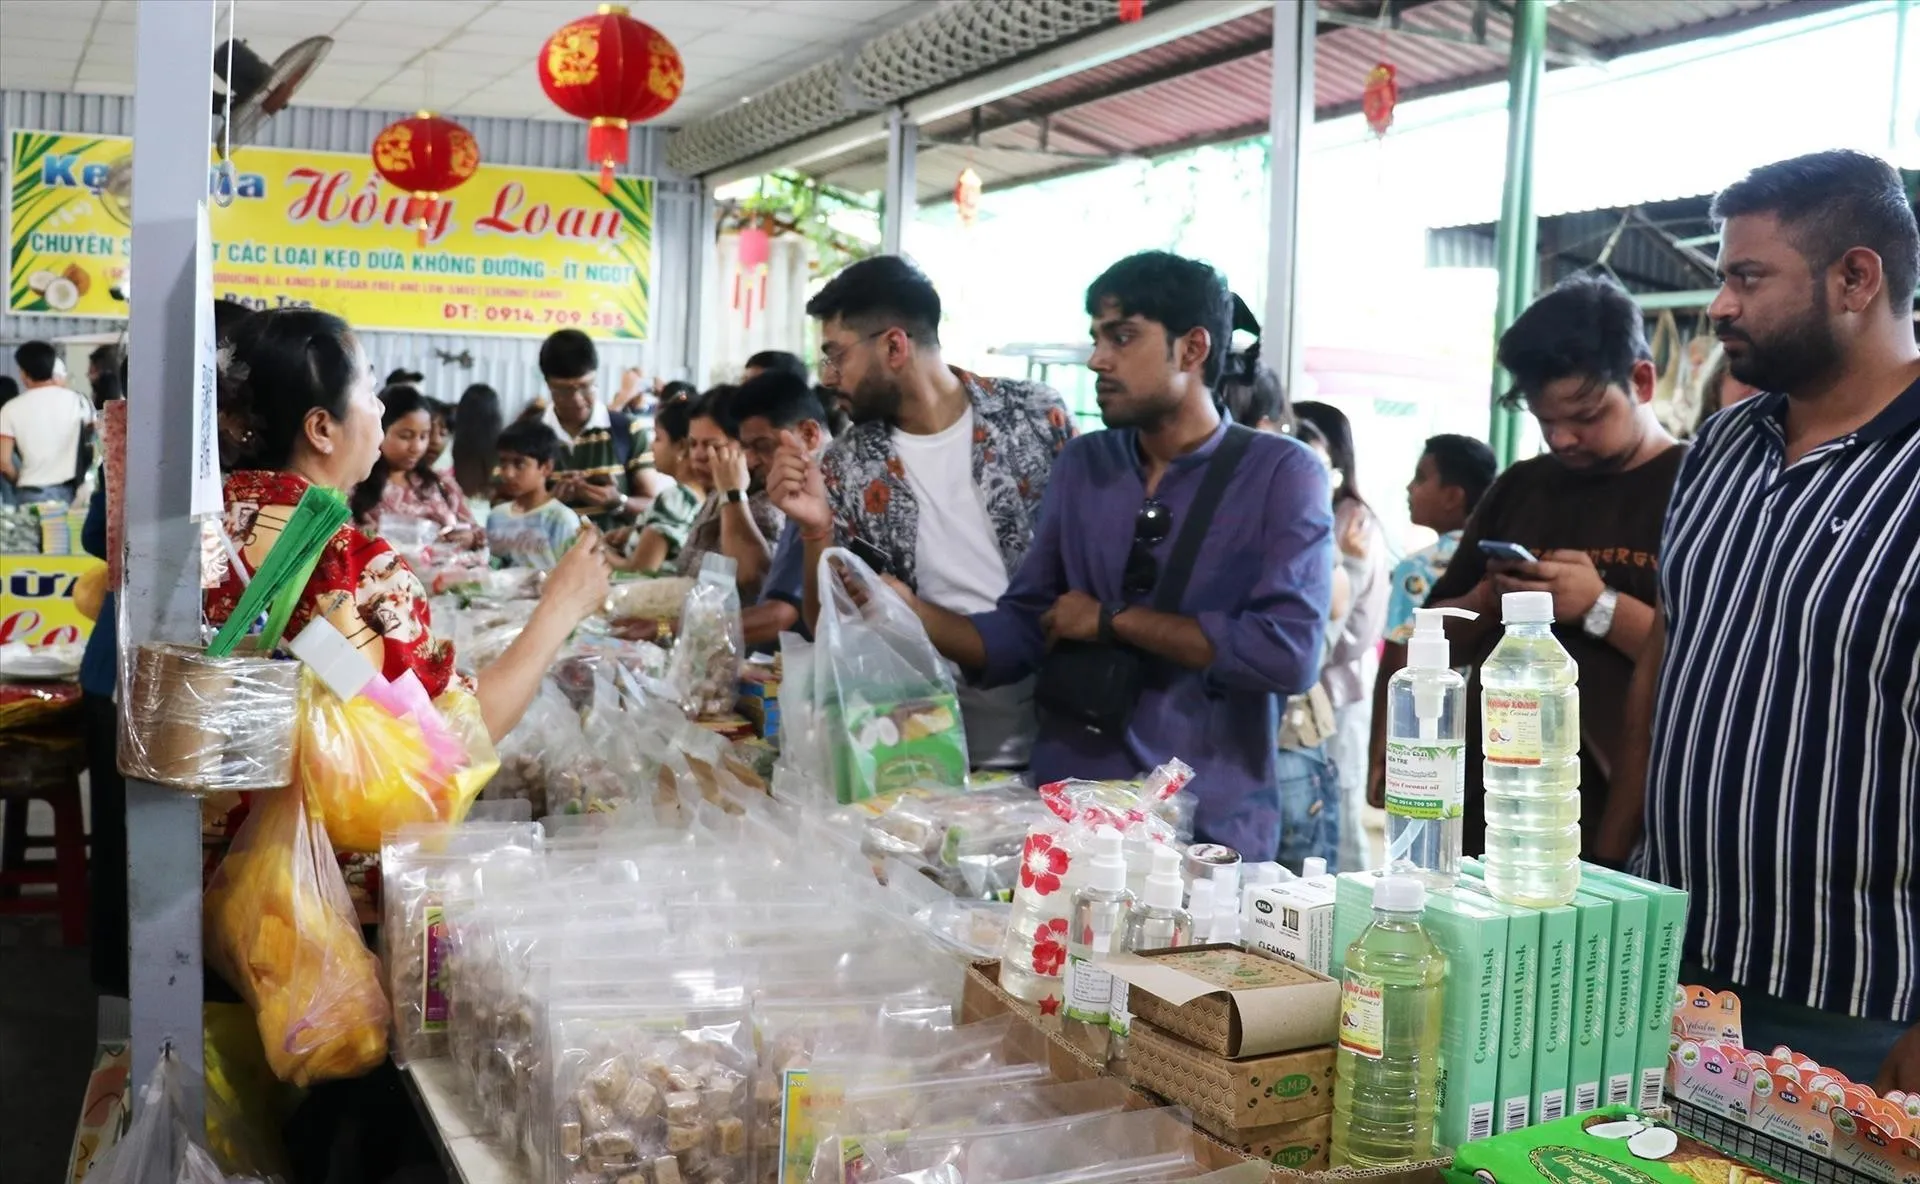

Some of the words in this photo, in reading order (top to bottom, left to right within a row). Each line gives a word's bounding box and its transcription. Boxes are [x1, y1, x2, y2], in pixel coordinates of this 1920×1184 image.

[42, 154, 109, 195] Kẹ
[475, 182, 624, 239] Loan
[31, 231, 114, 256] CHUYÊN
[228, 239, 266, 263] CÁC
[274, 246, 317, 270] LOẠI
[324, 249, 361, 271] KẸO
[368, 248, 405, 270] DỪA
[412, 252, 476, 275] KHÔNG
[1514, 944, 1526, 984] Mask
[1551, 939, 1563, 978] Mask
[1586, 933, 1598, 972] Mask
[1621, 927, 1633, 964] Mask
[1481, 948, 1494, 987] Mask
[1649, 963, 1668, 1031] Coconut
[1660, 921, 1673, 959] Mask
[1509, 988, 1523, 1059] Coconut
[1545, 983, 1560, 1053] Coconut
[1579, 977, 1595, 1046] Coconut
[1614, 969, 1629, 1037] Coconut
[1474, 993, 1490, 1064] Coconut
